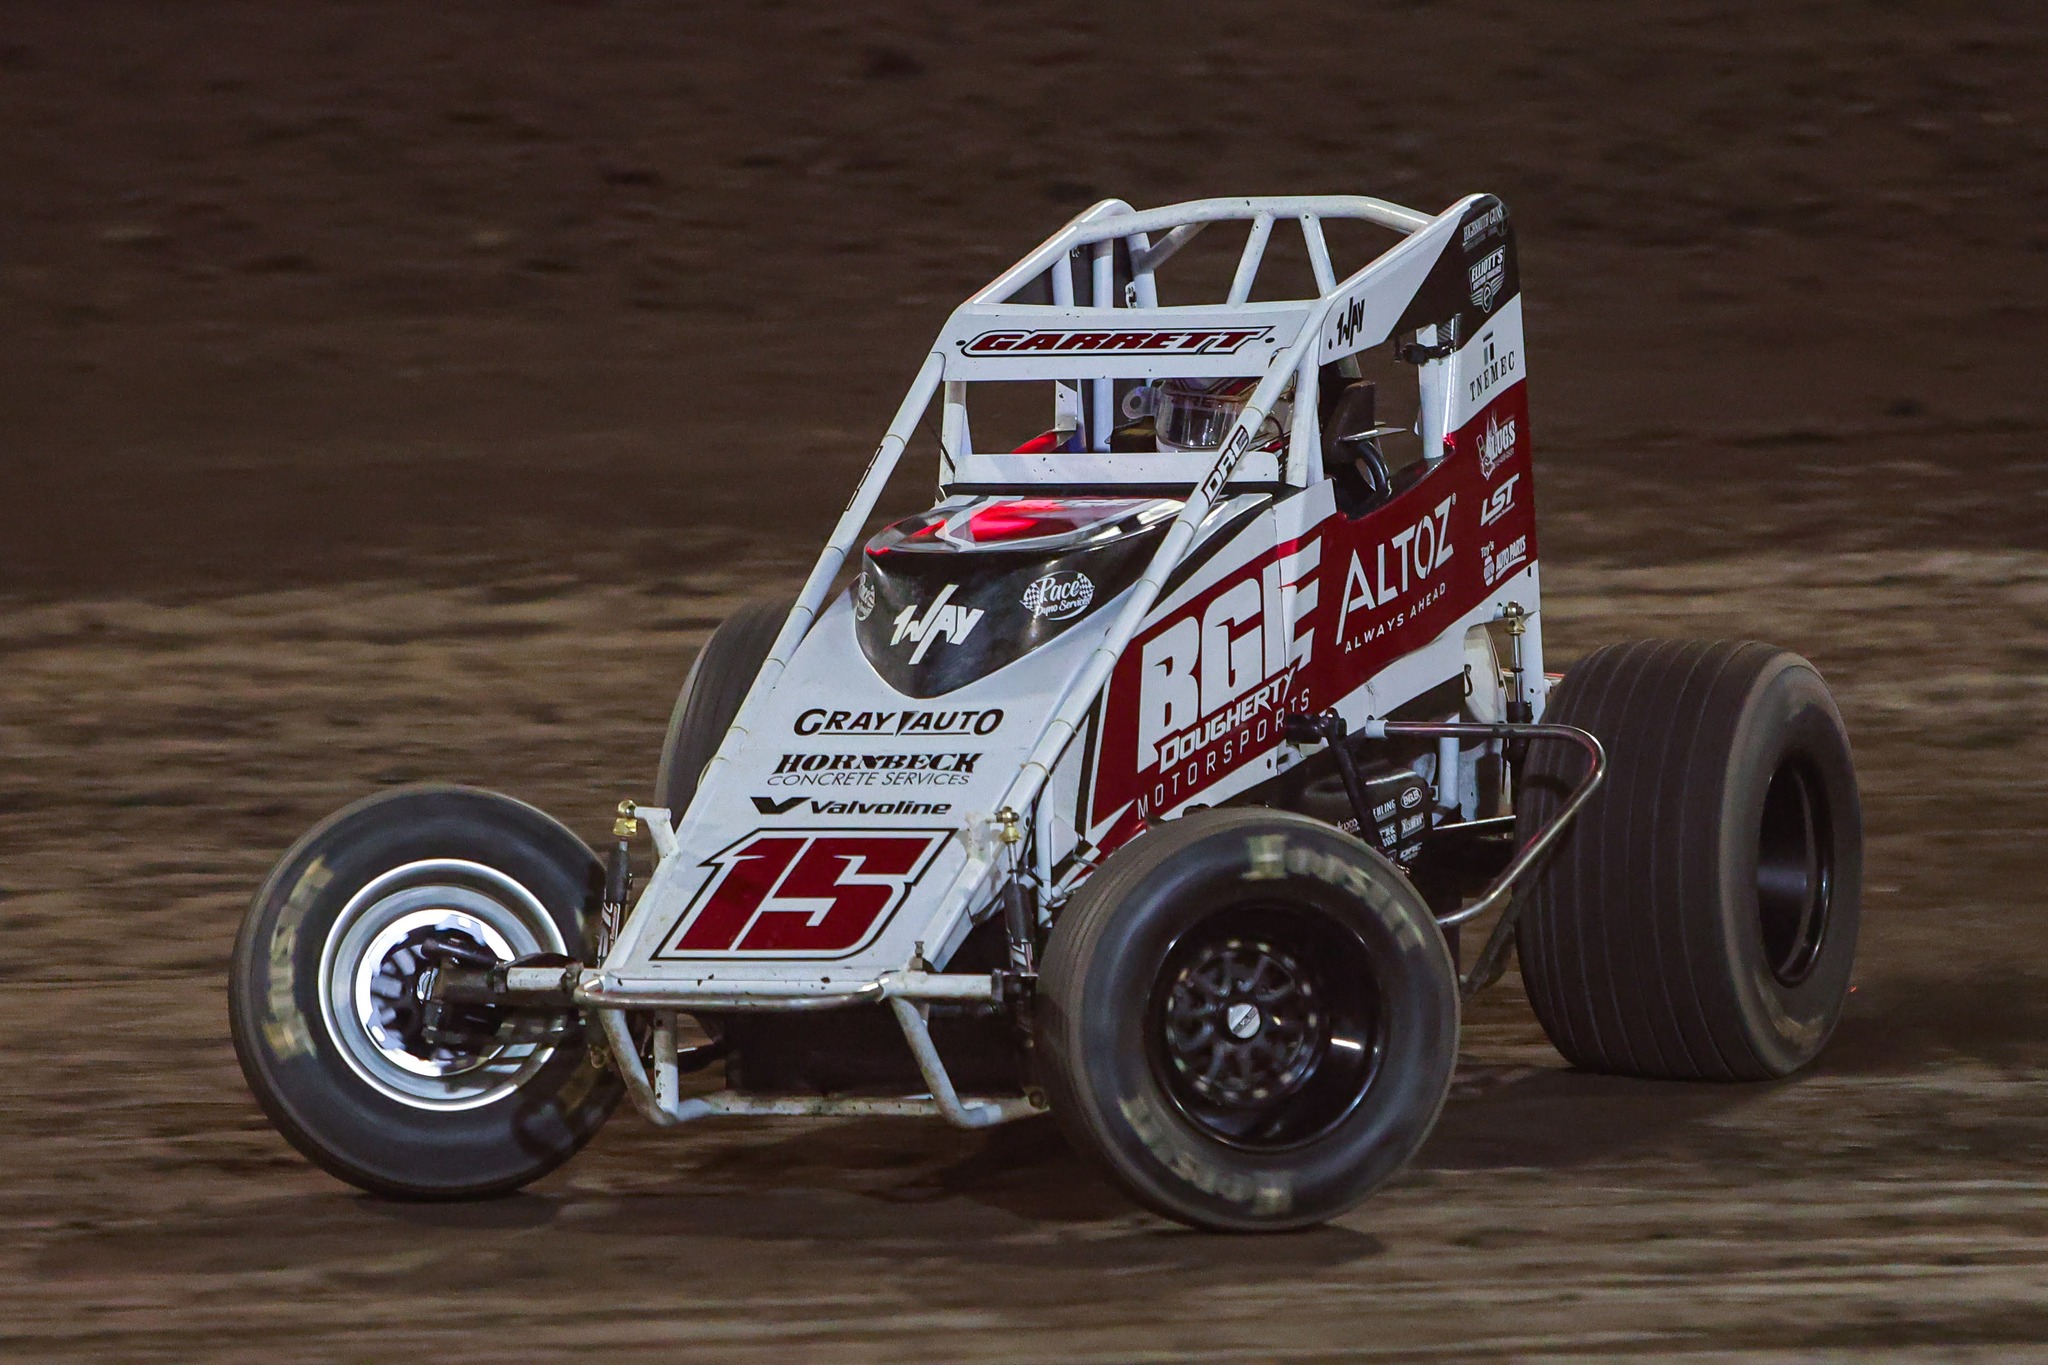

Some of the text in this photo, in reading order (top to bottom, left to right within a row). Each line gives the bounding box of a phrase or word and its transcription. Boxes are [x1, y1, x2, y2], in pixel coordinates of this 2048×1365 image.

[1471, 248, 1504, 283] ELLIOTT'S
[968, 329, 1266, 354] GARRETT
[1469, 351, 1515, 402] TNEMEC
[1480, 472, 1520, 527] LST
[1039, 577, 1081, 604] Race
[1345, 582, 1446, 654] ALWAYS AHEAD
[1137, 535, 1322, 774] BGE
[793, 708, 1004, 737] GRAY AUTO
[1159, 666, 1296, 774] DOUGHERTY
[772, 753, 983, 775] HORNBECK
[1137, 688, 1310, 820] MOTORSPORTS
[767, 771, 970, 787] CONCRETE SERVICES
[810, 800, 952, 815] Valvoline
[674, 837, 934, 951] 15
